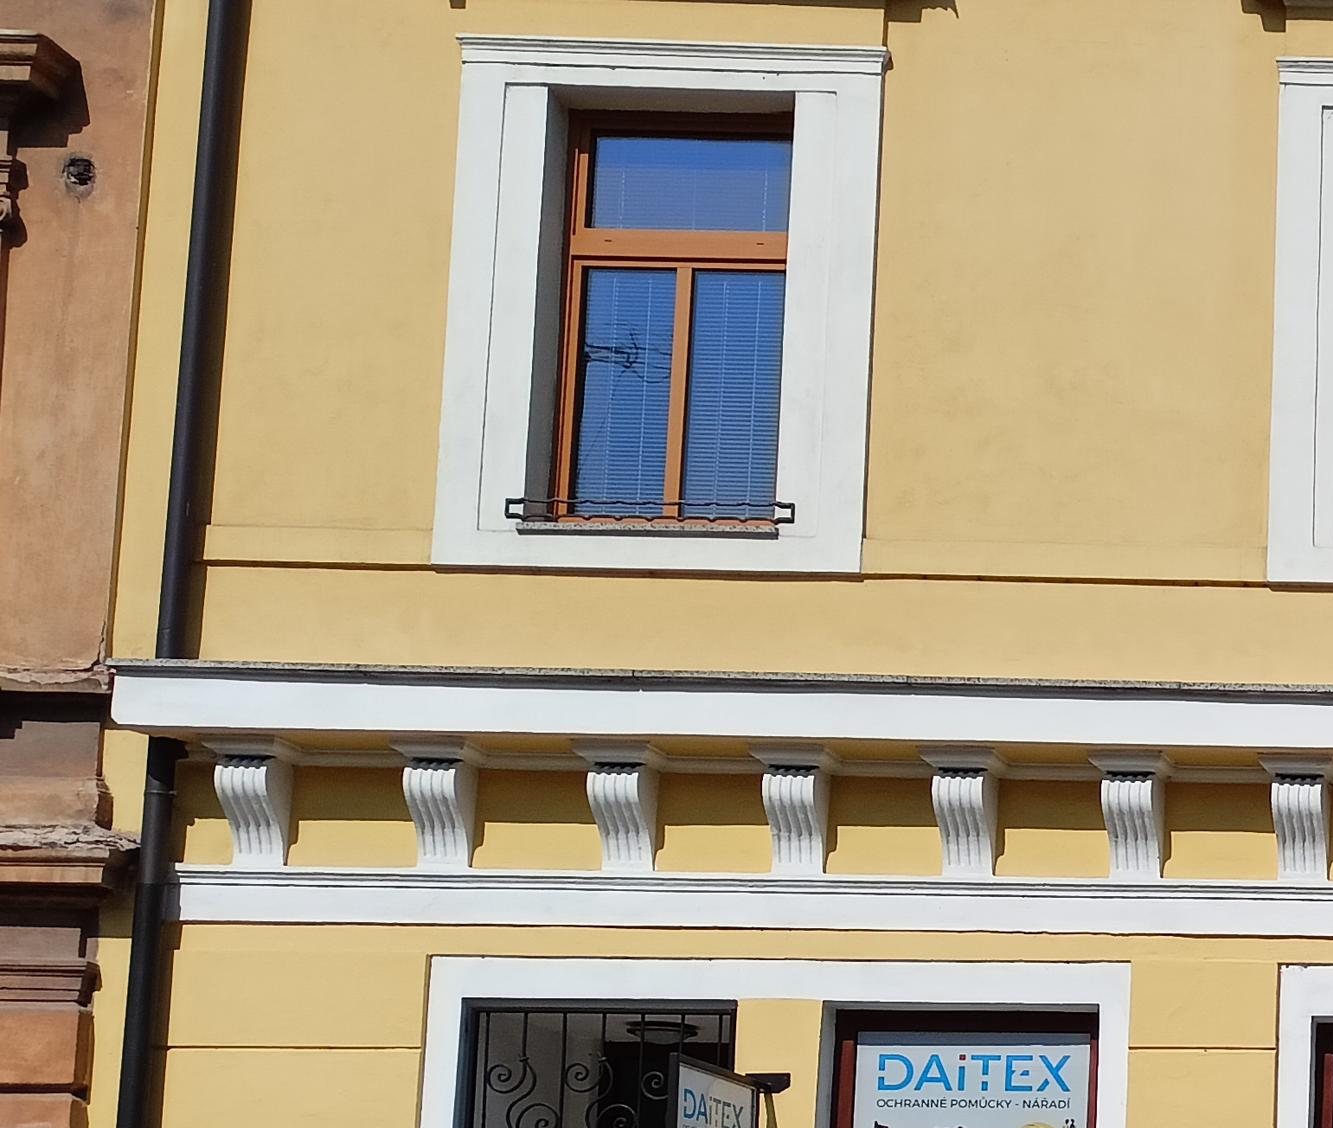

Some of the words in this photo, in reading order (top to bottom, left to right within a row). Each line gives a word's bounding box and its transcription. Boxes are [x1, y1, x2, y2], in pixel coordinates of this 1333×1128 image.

[876, 1096, 948, 1109] OCHRANNÉ
[950, 1096, 1012, 1109] POMŮCKY
[1022, 1097, 1071, 1109] NÁŘADÍ
